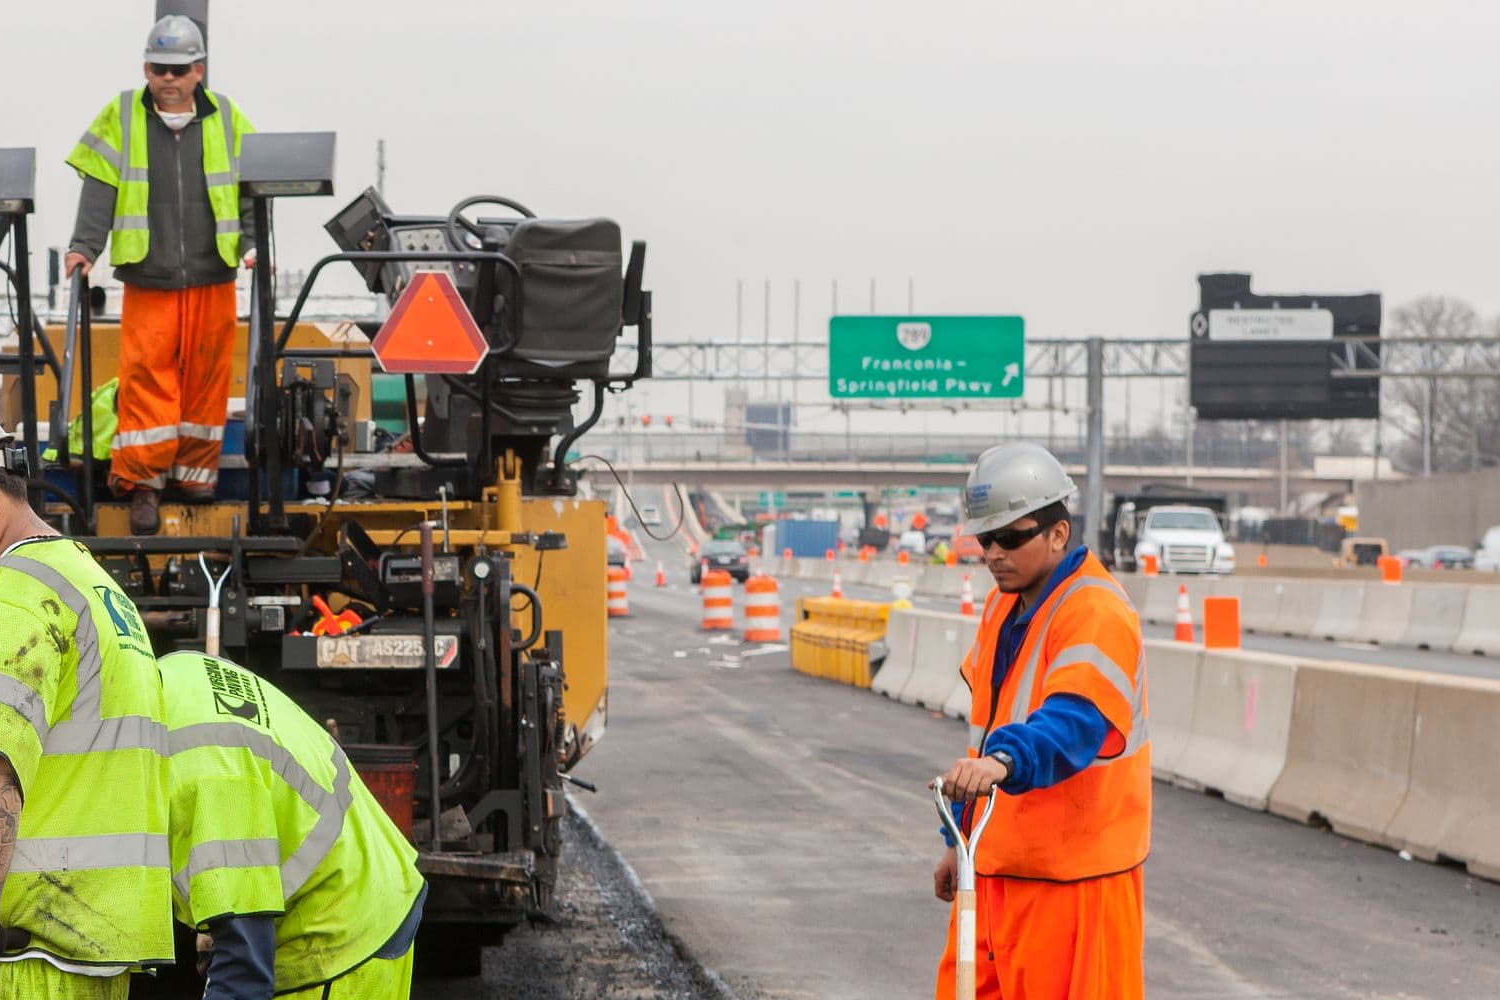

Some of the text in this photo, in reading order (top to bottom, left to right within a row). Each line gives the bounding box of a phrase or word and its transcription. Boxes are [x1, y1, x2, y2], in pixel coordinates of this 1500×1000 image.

[861, 356, 953, 371] Franconia
[837, 377, 992, 395] Springfield Pkwy
[322, 638, 444, 662] CAT AS225C
[203, 658, 227, 691] VIRGINIA
[222, 668, 245, 697] PAVING
[240, 673, 257, 702] COMPANY
